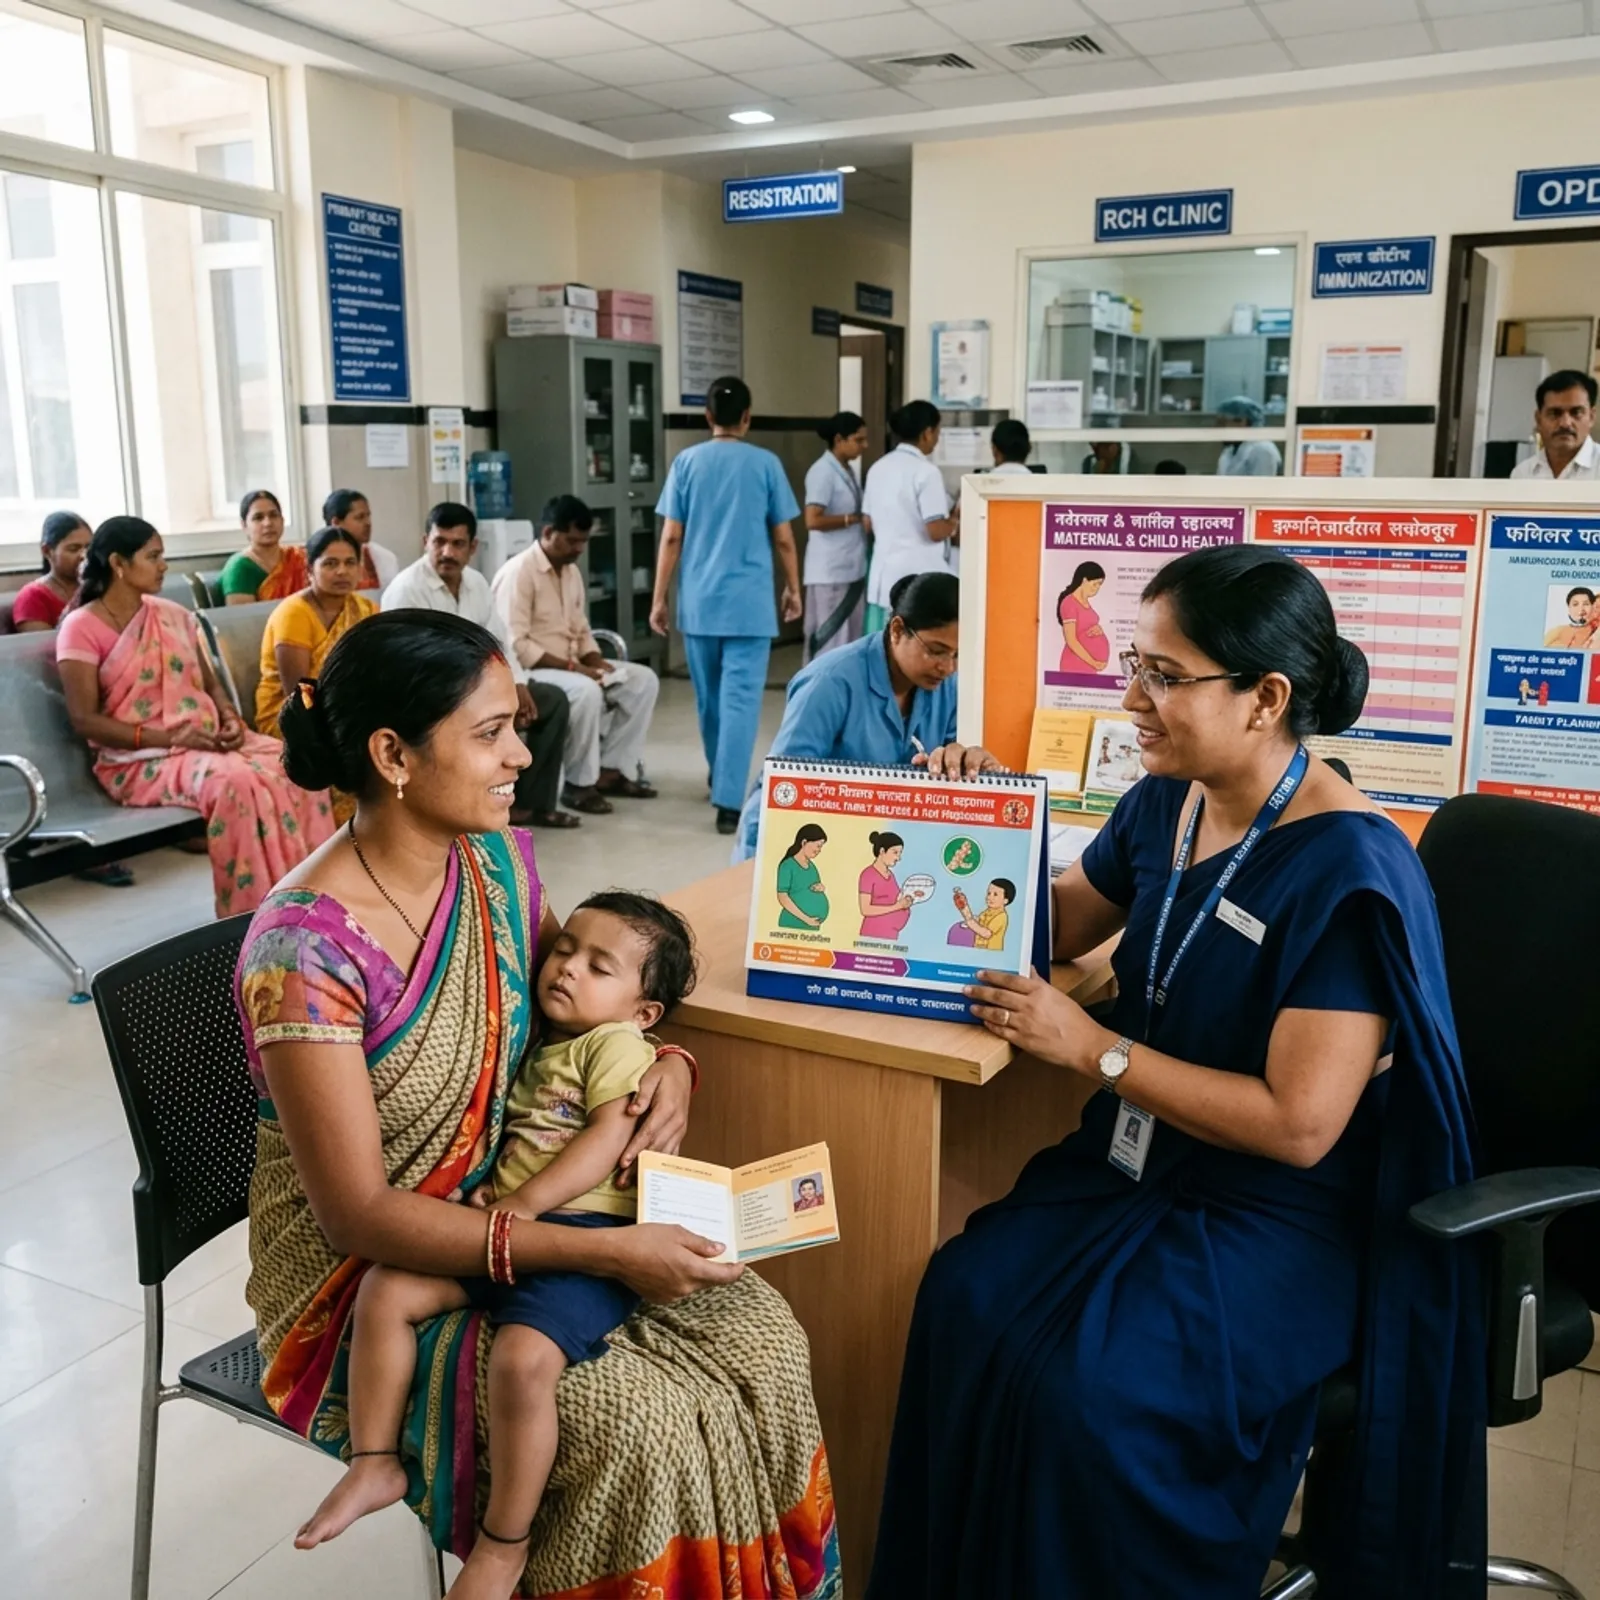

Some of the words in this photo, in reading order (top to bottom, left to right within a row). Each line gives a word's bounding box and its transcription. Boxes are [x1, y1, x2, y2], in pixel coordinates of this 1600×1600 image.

[1537, 178, 1600, 207] OPD
[1103, 207, 1147, 230] RCH
[1152, 202, 1223, 226] CLINIC
[1053, 531, 1123, 547] MATERNAL
[1125, 533, 1136, 547] &
[1138, 534, 1178, 549] CHILD
